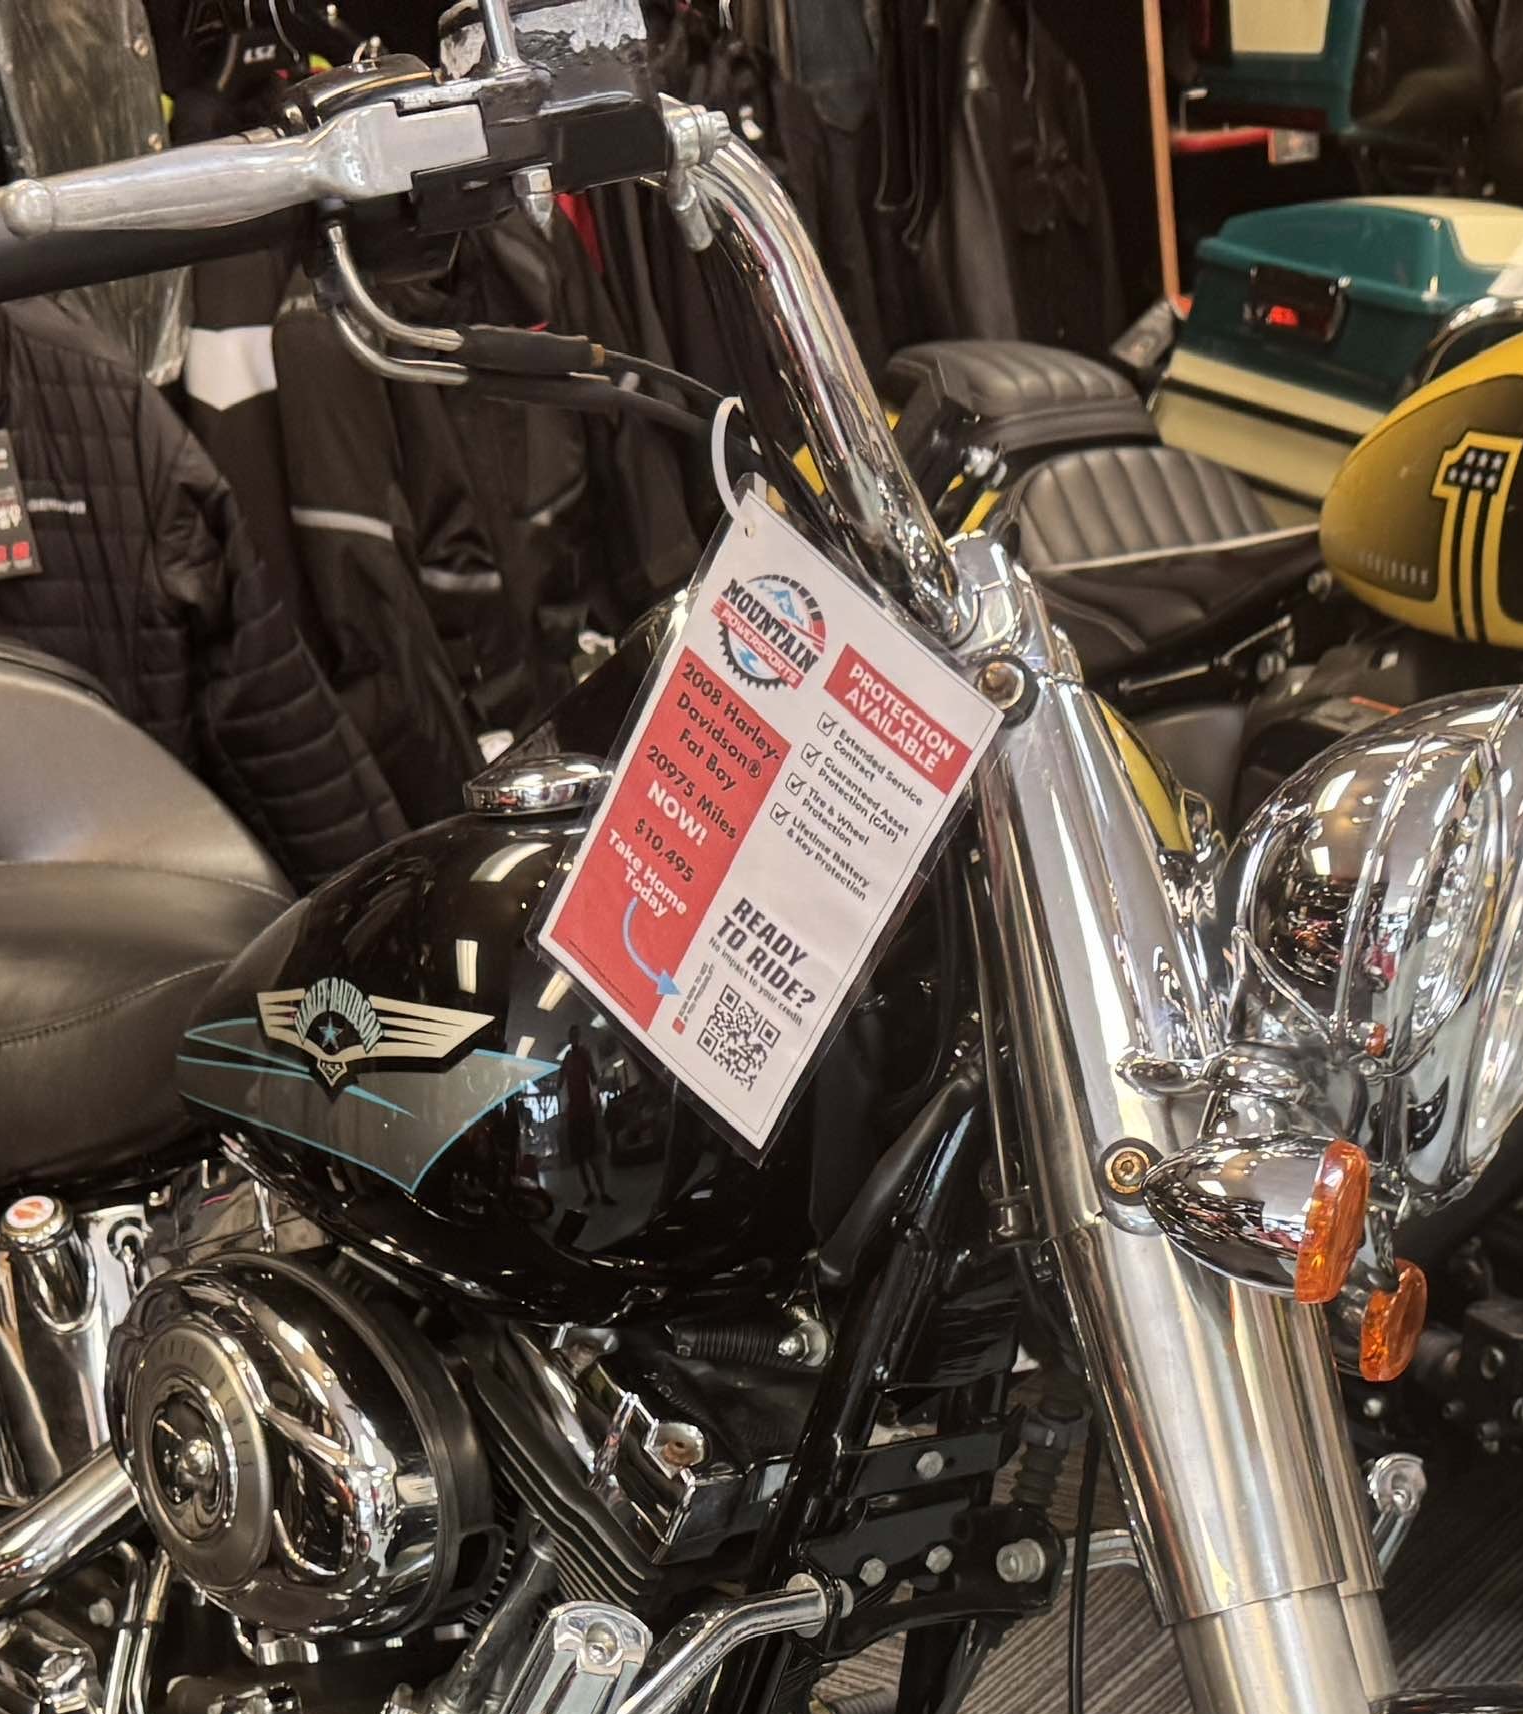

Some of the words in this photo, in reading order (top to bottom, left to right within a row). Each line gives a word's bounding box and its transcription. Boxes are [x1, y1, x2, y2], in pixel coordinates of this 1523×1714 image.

[718, 605, 801, 687] POWERSPORTS
[719, 576, 819, 677] MOUNTAIN
[680, 660, 723, 708] 2008
[720, 699, 784, 767] Harley-
[843, 683, 939, 776] AVAILABLE
[847, 661, 955, 764] PROTECTION
[644, 743, 697, 799] 20975
[695, 792, 740, 841] Miles
[677, 728, 705, 761] Fat
[701, 753, 738, 797] Boy
[822, 756, 880, 812] Guaranteed
[879, 806, 909, 837] Asset
[831, 739, 876, 783] Contract
[838, 727, 886, 774] Extended
[884, 769, 923, 808] Service
[645, 779, 709, 847] NOW!
[801, 797, 853, 848] Protection
[807, 787, 828, 810] Tire
[827, 804, 836, 817] &
[836, 812, 869, 846] Wheel
[817, 766, 870, 818] Protection
[867, 812, 898, 845] (GAP)
[606, 829, 645, 872] Take
[641, 865, 689, 918] Home
[632, 816, 696, 884] $10,495
[791, 816, 831, 857] Lifetime
[830, 851, 870, 892] Battery
[792, 833, 814, 858] Key
[813, 850, 867, 903] Protection
[620, 866, 670, 921] Today
[715, 915, 751, 958] TO
[746, 941, 816, 1016] RIDE?
[731, 894, 808, 974] READY
[720, 948, 749, 980] impact
[748, 974, 758, 988] to
[757, 985, 777, 1007] your
[777, 1000, 802, 1027] credit
